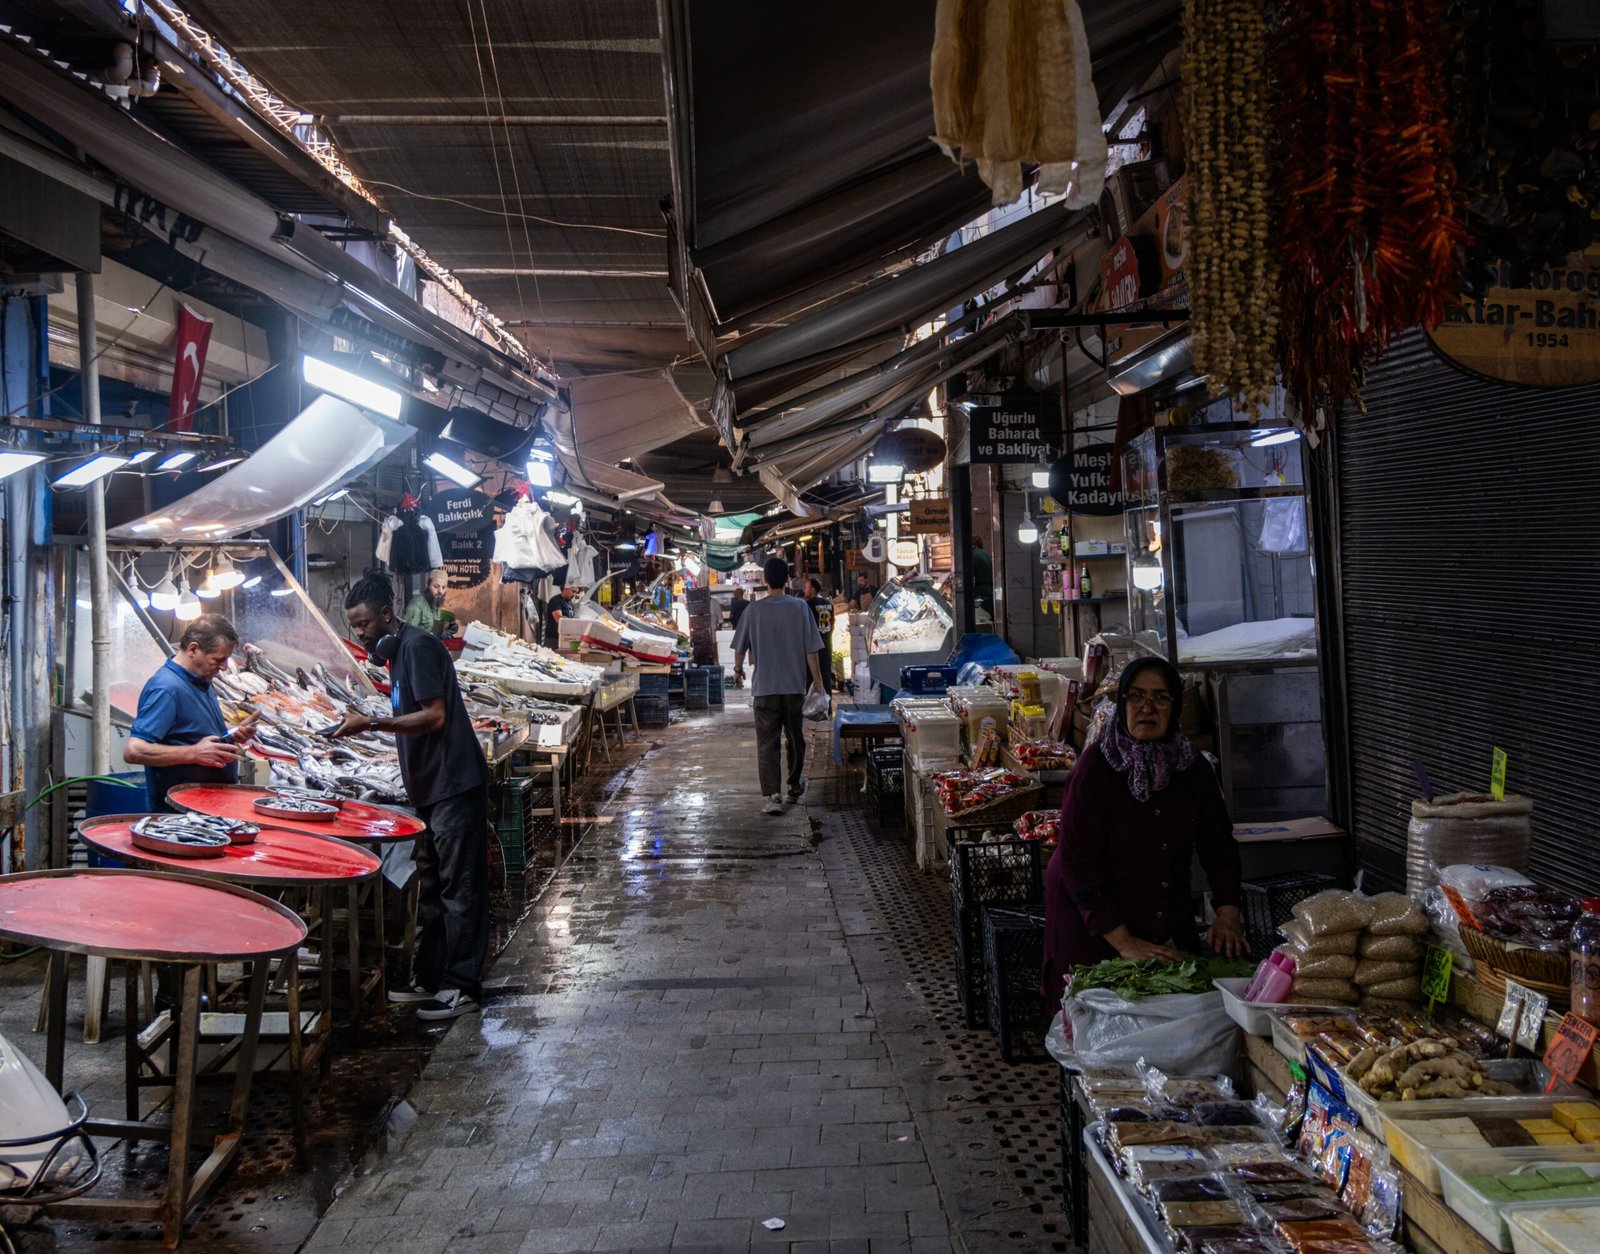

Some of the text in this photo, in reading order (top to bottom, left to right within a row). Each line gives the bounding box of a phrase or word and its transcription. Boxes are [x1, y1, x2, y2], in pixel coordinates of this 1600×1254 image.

[1445, 300, 1600, 329] ktar-Bah
[1526, 332, 1569, 347] 1954
[992, 411, 1036, 427] Uğurlu
[988, 427, 1040, 440] Baharat
[977, 442, 1051, 458] ve Bakliyat
[446, 499, 472, 510] Ferdi
[1067, 489, 1122, 506] Kadayı
[438, 509, 483, 522] Balıkçılık
[451, 540, 482, 549] Balık 2
[459, 564, 481, 574] HOTEL
